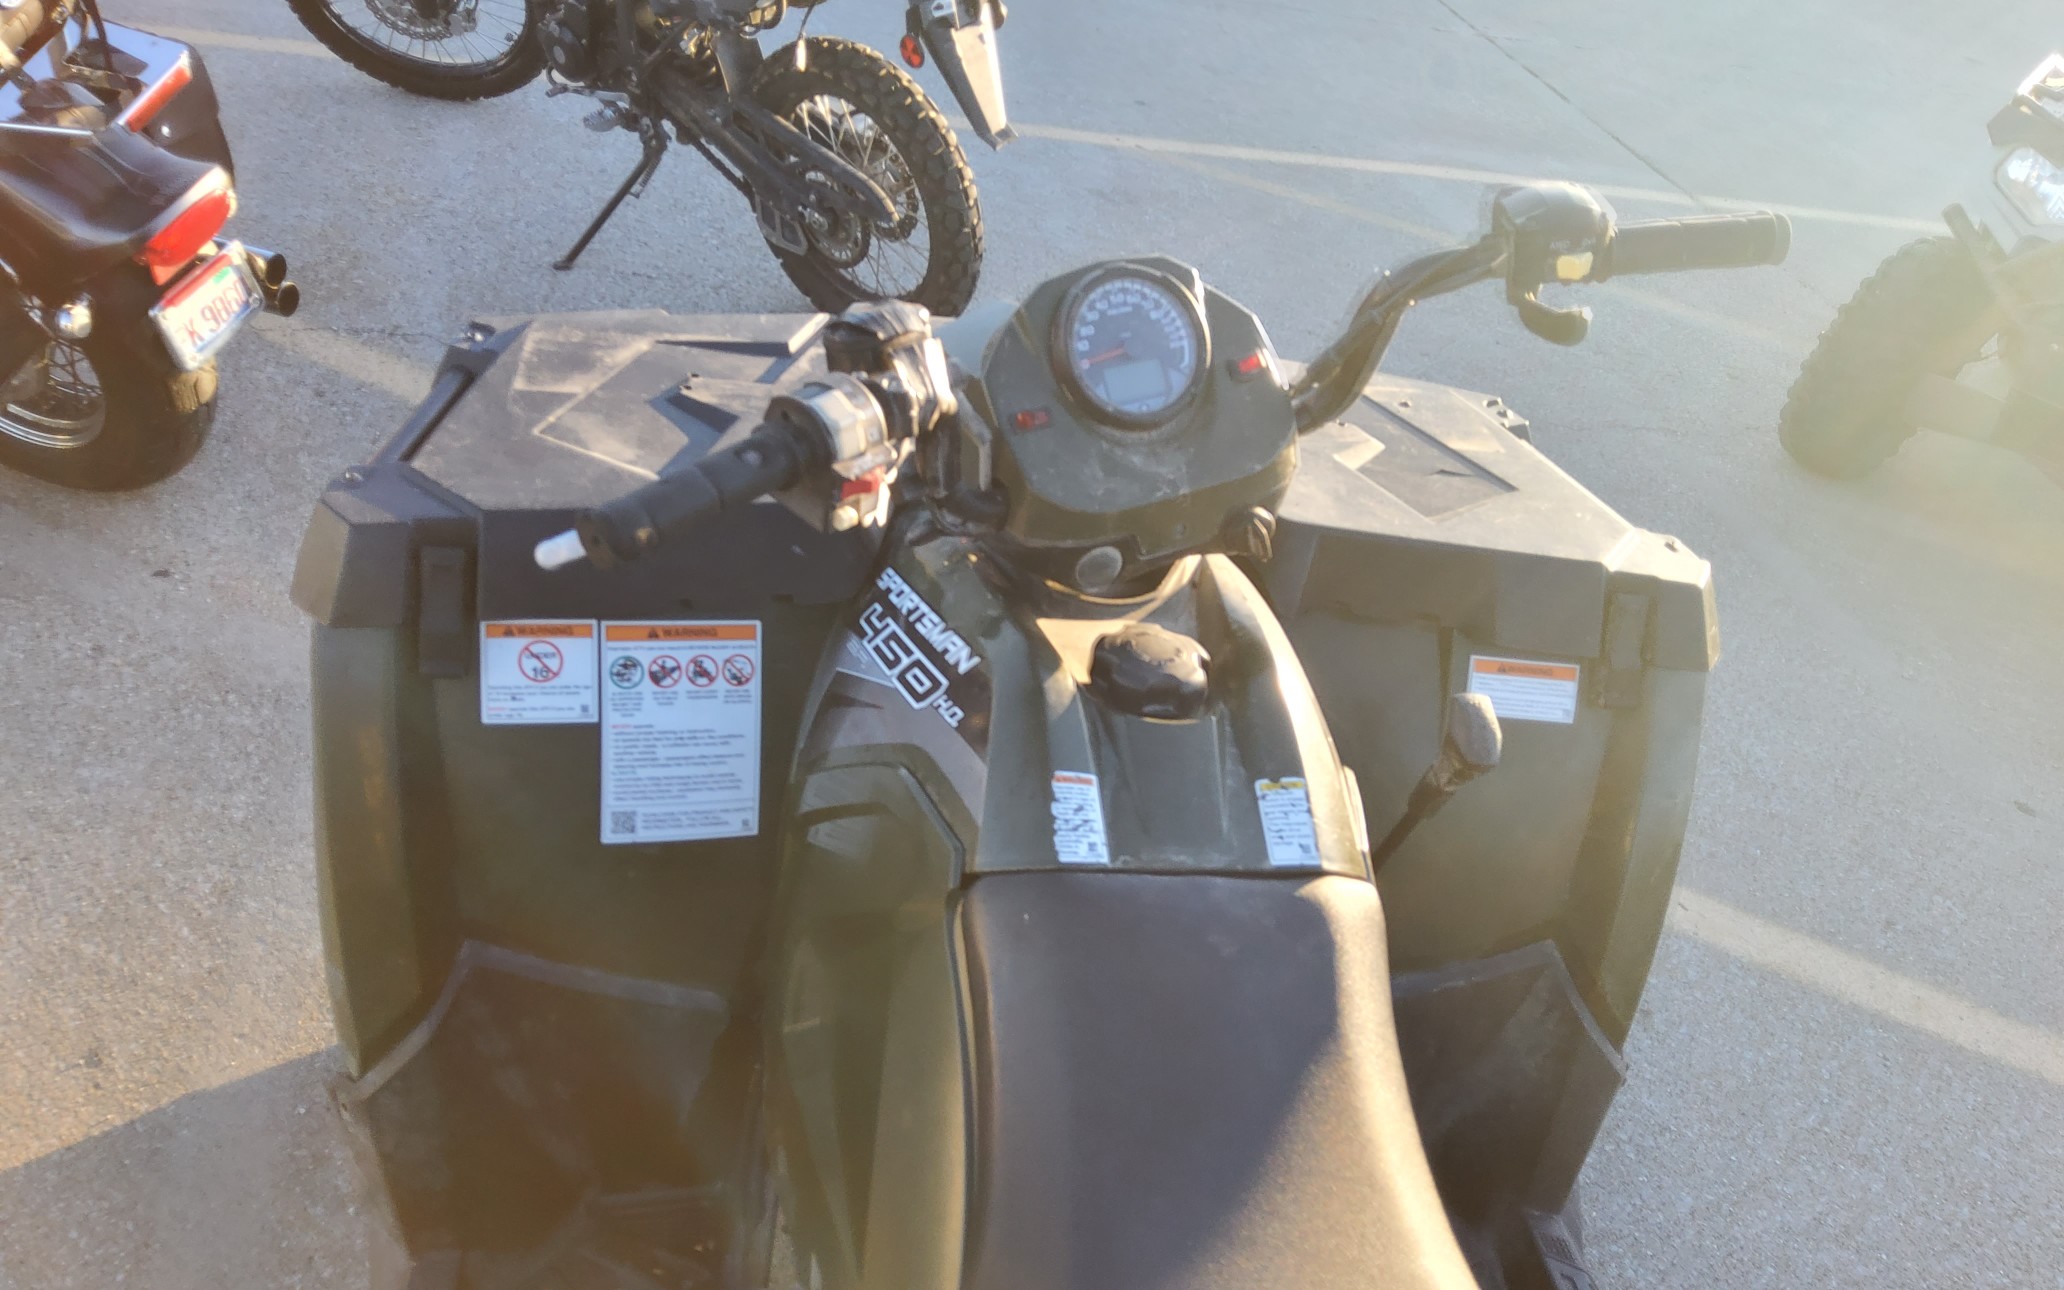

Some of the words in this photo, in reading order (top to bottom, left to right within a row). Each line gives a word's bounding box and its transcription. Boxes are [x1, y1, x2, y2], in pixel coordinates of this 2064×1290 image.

[532, 666, 549, 680] 16
[859, 602, 950, 710] 450
[876, 566, 982, 675] SPORTSMAN
